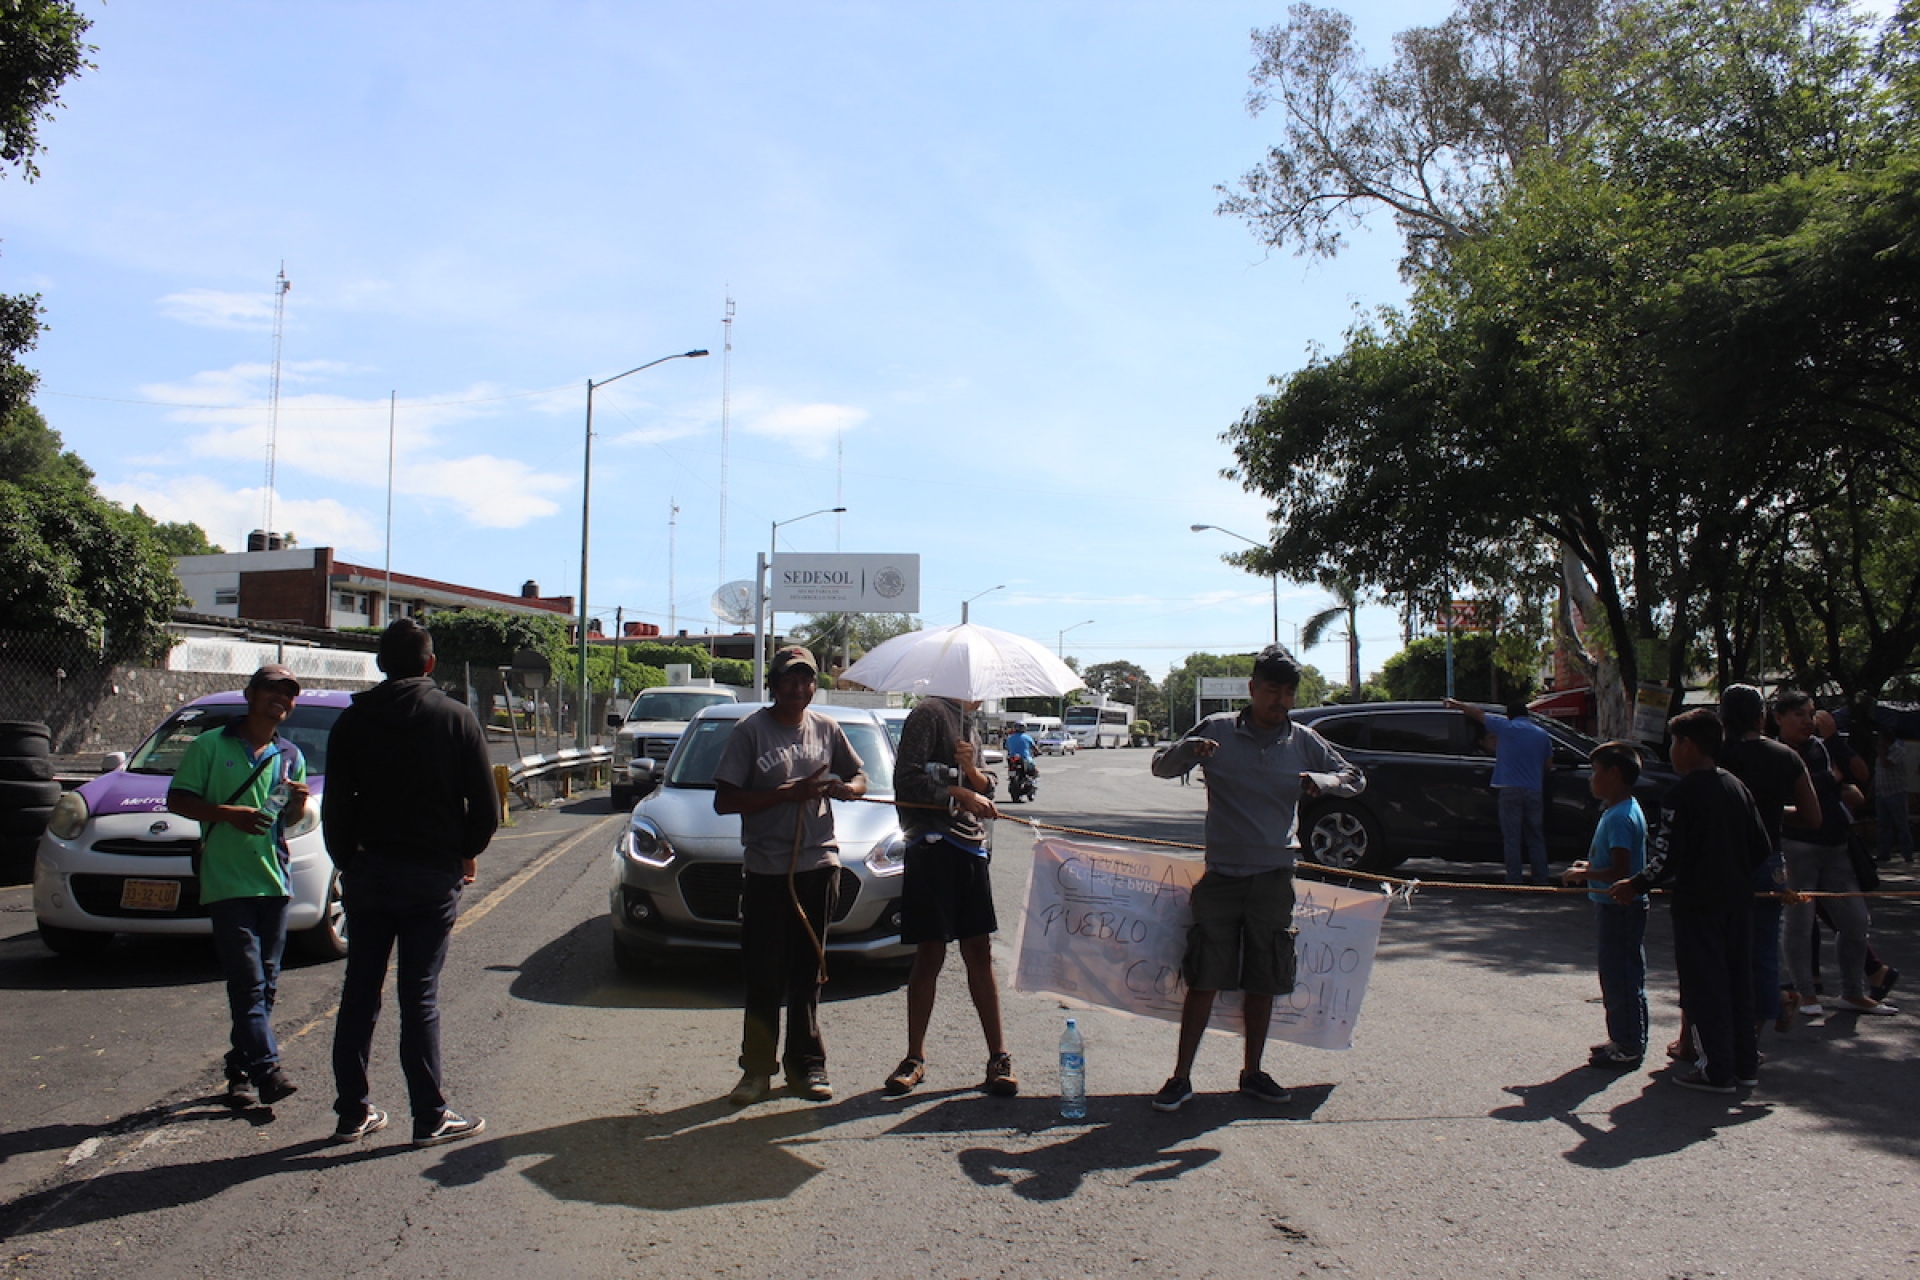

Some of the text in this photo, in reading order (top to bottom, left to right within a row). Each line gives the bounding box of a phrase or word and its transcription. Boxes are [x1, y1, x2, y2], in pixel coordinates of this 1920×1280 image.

[783, 570, 854, 585] SEDESOL
[1057, 857, 1130, 897] CFE
[1039, 903, 1148, 944] PUEBLO
